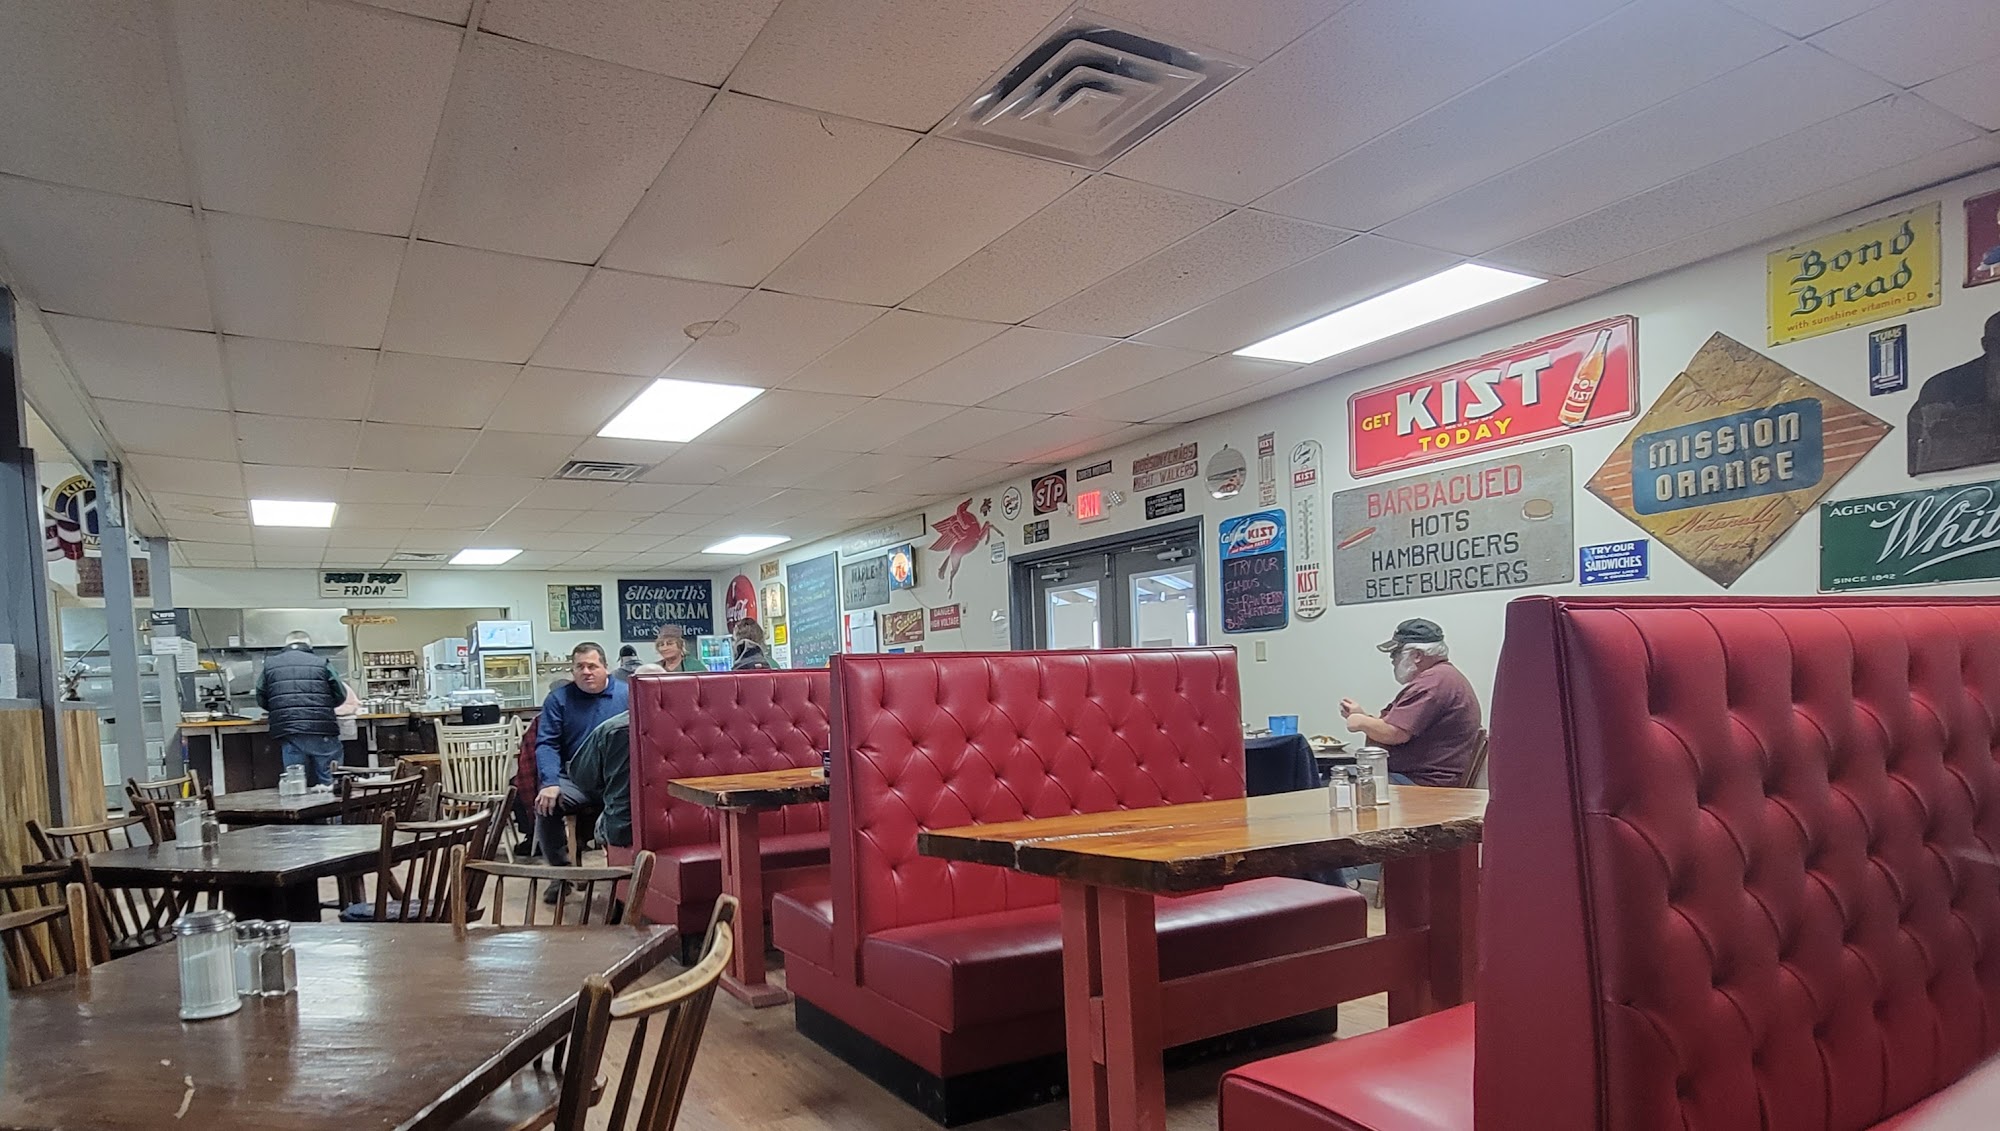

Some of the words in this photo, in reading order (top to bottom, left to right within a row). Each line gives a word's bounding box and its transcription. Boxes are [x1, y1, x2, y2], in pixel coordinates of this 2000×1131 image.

[1787, 220, 1915, 285] Bond
[1788, 258, 1912, 317] Bread
[1787, 319, 1809, 332] with
[1812, 307, 1857, 327] sunshine
[1873, 327, 1902, 343] TUMS
[1397, 352, 1552, 436] KIST
[1570, 389, 1592, 400] KIST
[1361, 412, 1391, 431] GET
[1419, 416, 1512, 452] TODAY
[1650, 412, 1800, 469] MISSION
[1295, 471, 1314, 482] KIST
[1656, 451, 1793, 501] ORANGE
[1036, 479, 1064, 507] STP
[1367, 464, 1522, 519] BARBACUED
[1078, 491, 1100, 519] EXIT
[1830, 500, 1900, 518] AGENCY
[1411, 509, 1470, 538] HOTS
[1666, 496, 1790, 535] Naturally
[1248, 525, 1274, 540] KIST
[1372, 532, 1519, 572] HAMBRUGERS
[1590, 545, 1612, 554] TRY
[1613, 543, 1635, 552] OUR
[851, 564, 876, 583] MAPLE
[1228, 560, 1250, 577] TRY
[1255, 557, 1278, 575] OUR
[1296, 563, 1320, 572] ORANGE
[1298, 571, 1318, 593] KIST
[1366, 560, 1528, 599] BEEFBURGERS
[1833, 575, 1867, 584] SINCE
[1872, 573, 1896, 581] 1842
[344, 586, 386, 596] FRIDAY
[625, 584, 707, 600] Ellsworth's
[846, 586, 866, 603] SYRUP
[626, 603, 651, 620] ICE
[654, 602, 709, 620] CREAM
[933, 606, 955, 617] DANGER
[633, 625, 651, 636] For
[940, 616, 960, 627] VOLTAGE
